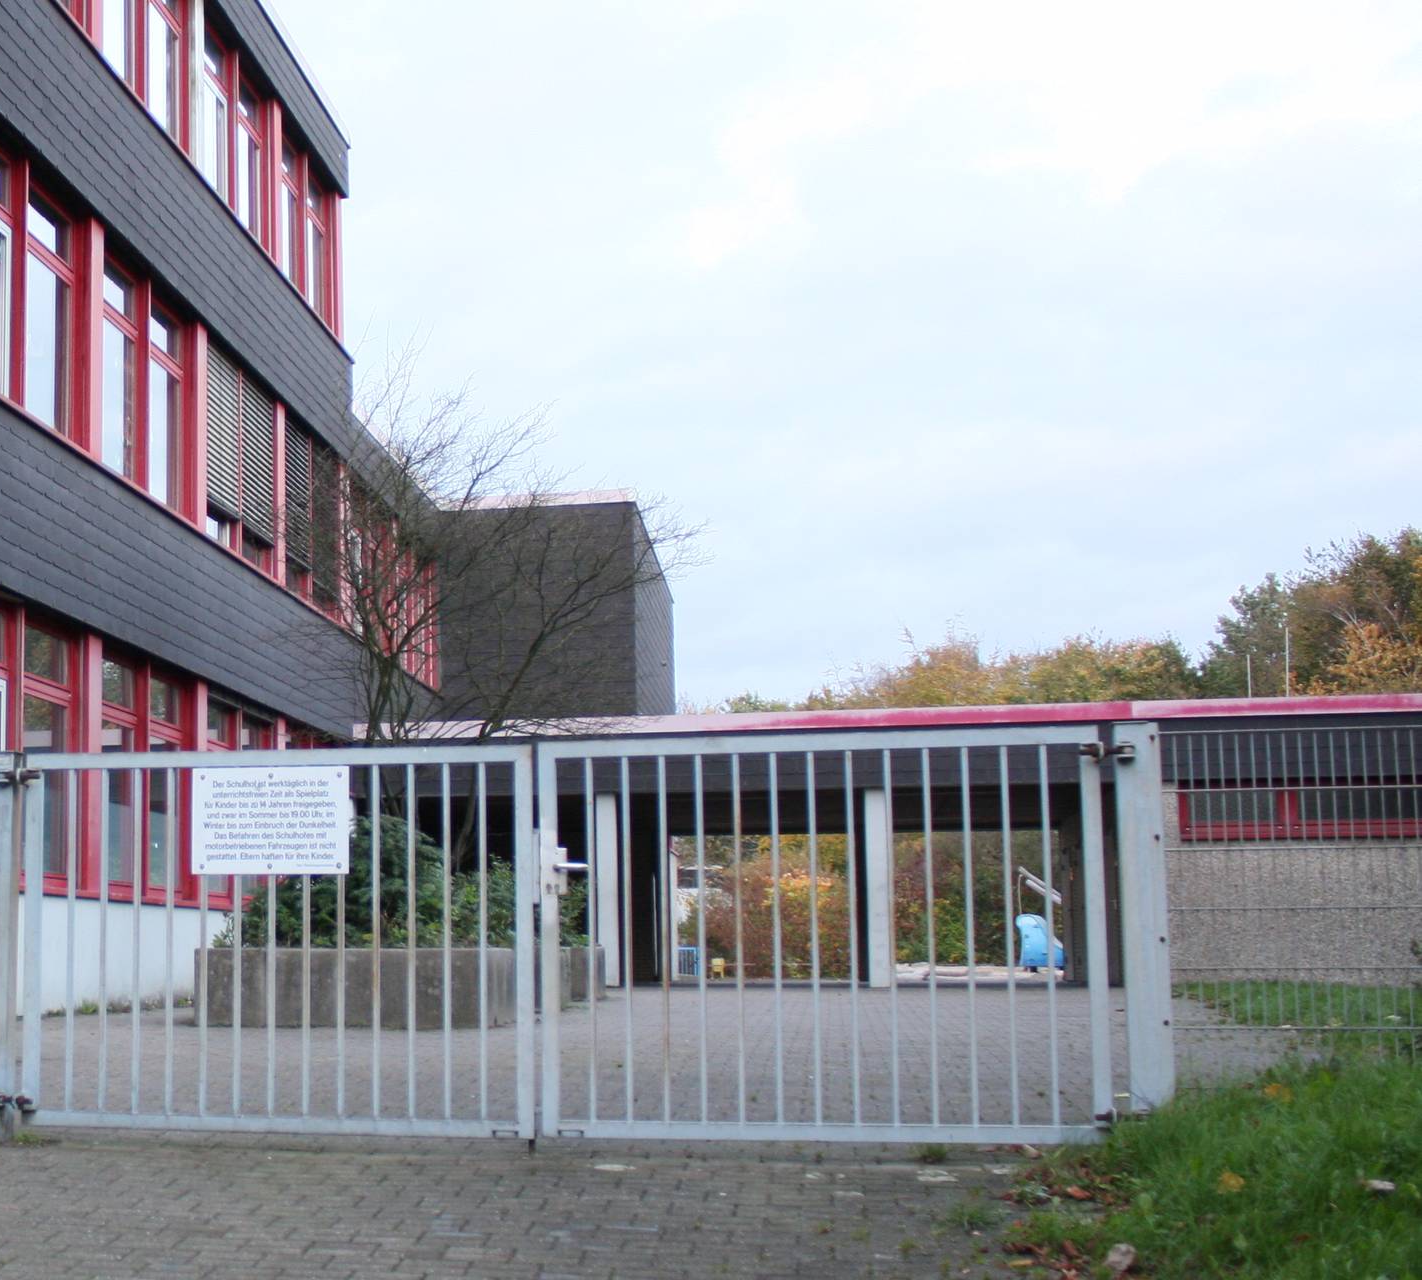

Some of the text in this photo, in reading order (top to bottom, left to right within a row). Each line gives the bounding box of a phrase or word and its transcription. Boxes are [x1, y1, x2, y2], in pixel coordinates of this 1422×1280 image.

[212, 780, 224, 788] Der
[317, 779, 329, 787] der
[284, 790, 294, 798] als
[296, 789, 328, 799] Spielplatz
[204, 800, 214, 808] für
[214, 800, 238, 808] Kinder
[238, 800, 249, 808] bis
[268, 800, 292, 808] Jahren
[248, 810, 278, 818] Sommer
[203, 821, 226, 829] Winter
[226, 821, 238, 829] bis
[254, 820, 284, 829] Einbruch
[286, 820, 298, 828] der
[214, 832, 228, 840] Das
[228, 832, 260, 840] Befahren
[261, 832, 274, 840] des
[275, 831, 315, 840] Schulhofes
[268, 842, 308, 850] Fahrzeugen
[309, 841, 318, 850] ist
[319, 841, 337, 849] nicht
[240, 852, 261, 860] Eltern
[262, 852, 284, 860] haften
[284, 852, 294, 860] für
[296, 852, 310, 860] ihre
